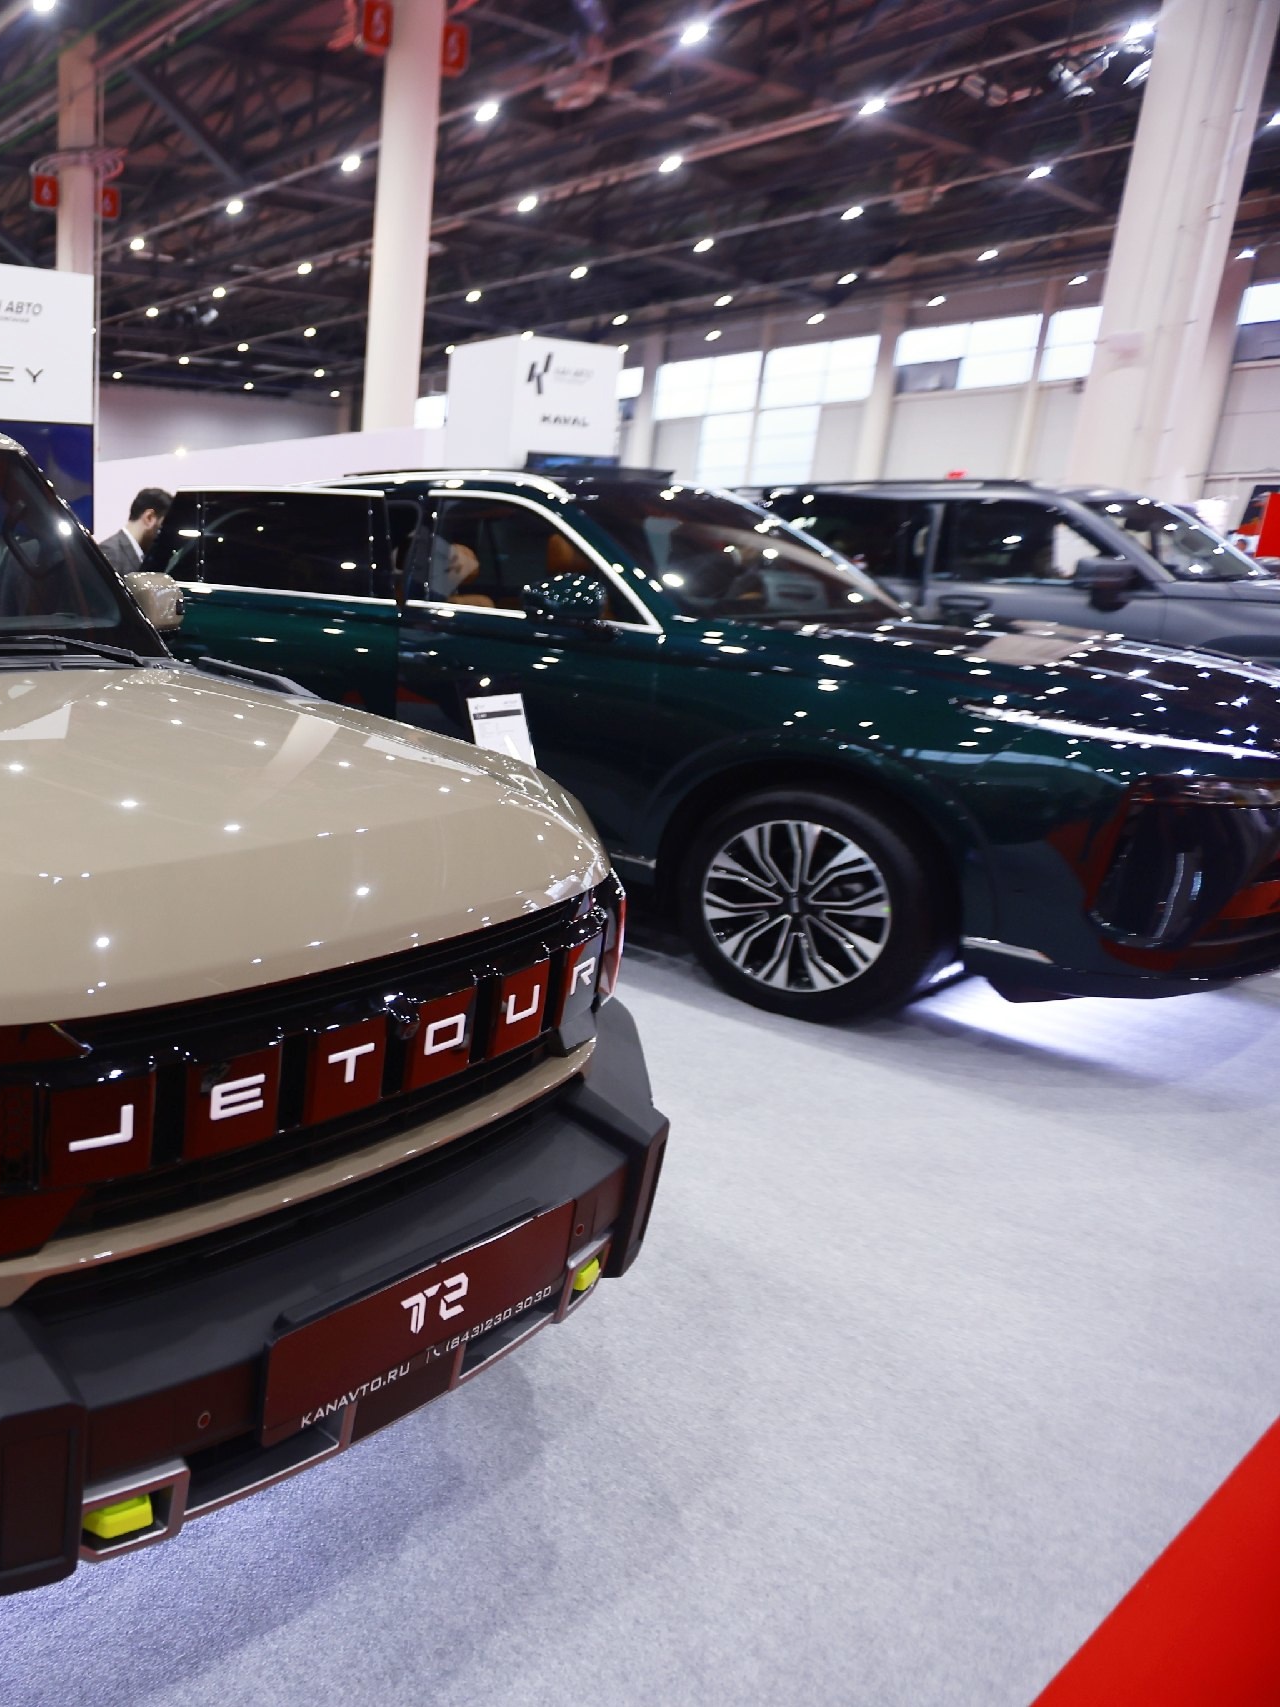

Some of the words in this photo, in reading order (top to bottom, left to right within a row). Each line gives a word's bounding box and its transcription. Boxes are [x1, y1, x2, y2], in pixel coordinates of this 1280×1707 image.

[4, 300, 43, 316] АВТО
[68, 956, 598, 1153] JETOUR
[400, 1271, 469, 1335] T2
[300, 1362, 411, 1429] KANAVTO.RU
